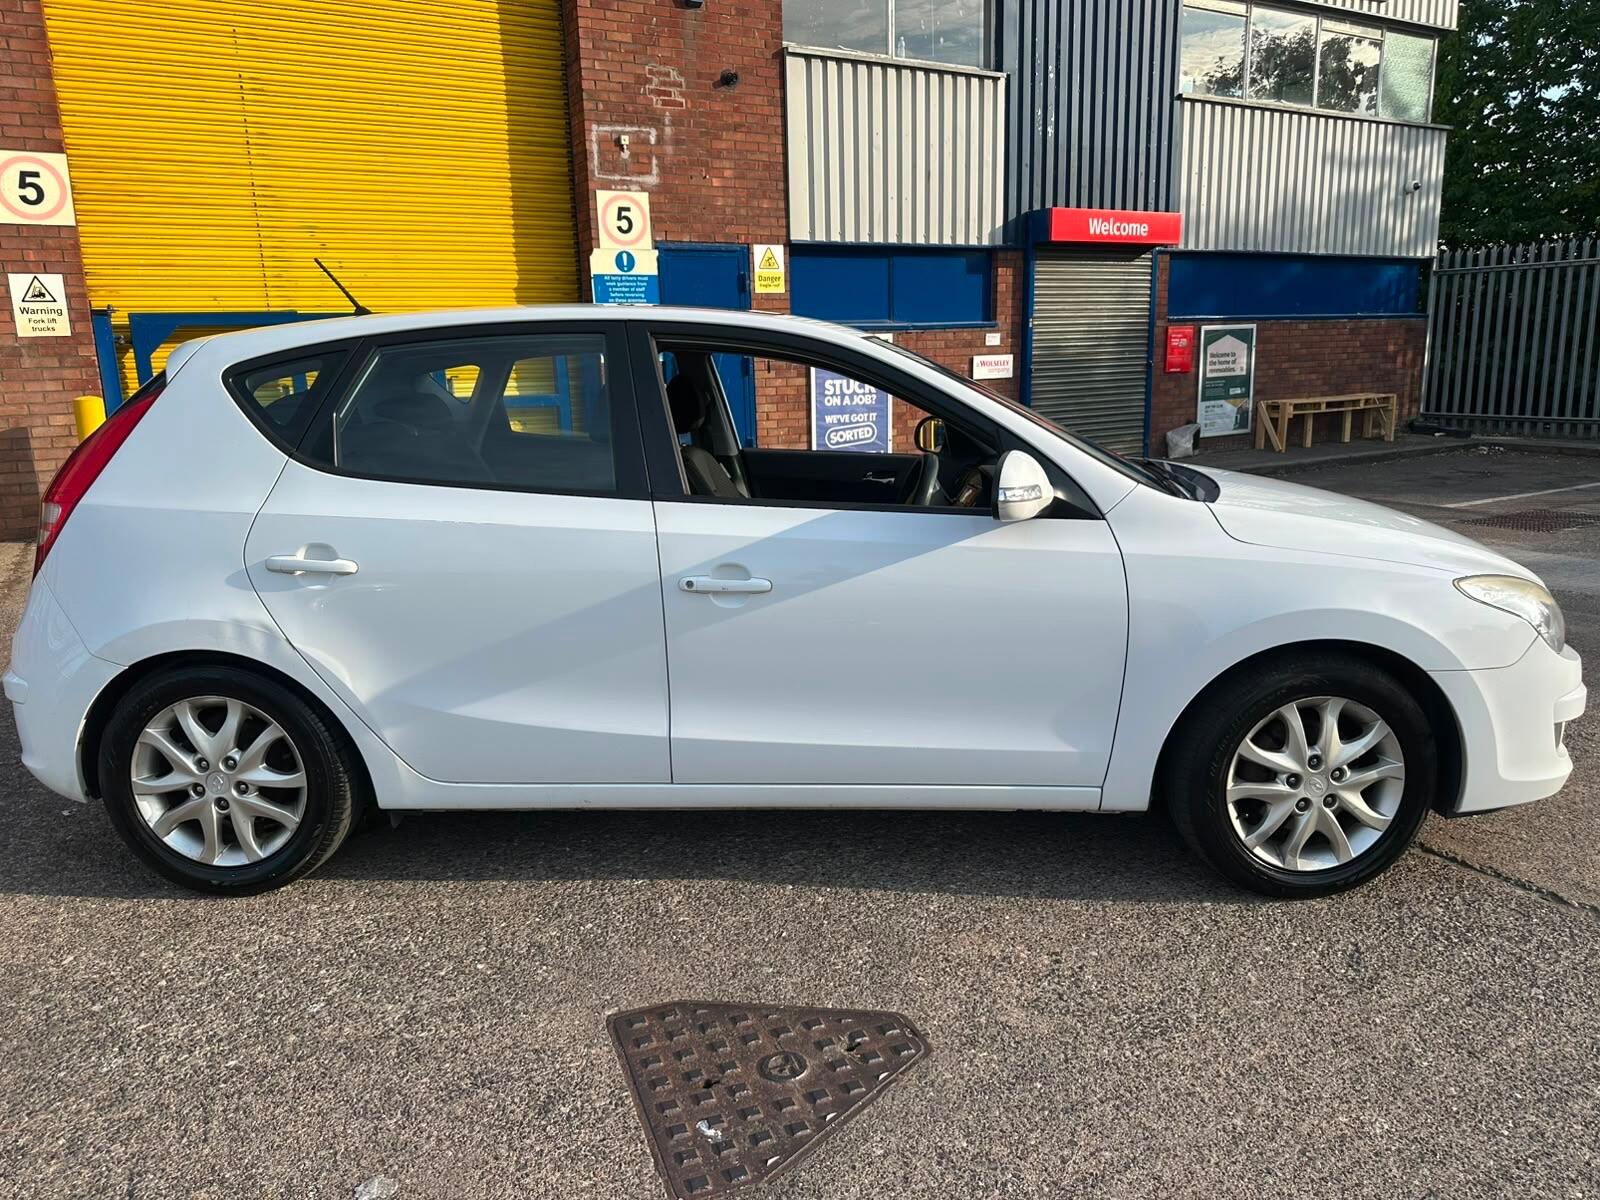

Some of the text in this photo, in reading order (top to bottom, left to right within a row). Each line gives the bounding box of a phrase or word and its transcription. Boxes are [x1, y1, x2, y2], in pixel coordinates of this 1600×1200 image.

[18, 170, 45, 206] 5
[616, 206, 633, 234] 5
[1088, 217, 1149, 237] Welcome
[758, 275, 781, 283] Danger
[19, 306, 63, 317] Warning
[824, 395, 877, 406] ON A JOB?
[825, 412, 877, 424] WE'VE GOT IT
[829, 427, 873, 444] SORTED
